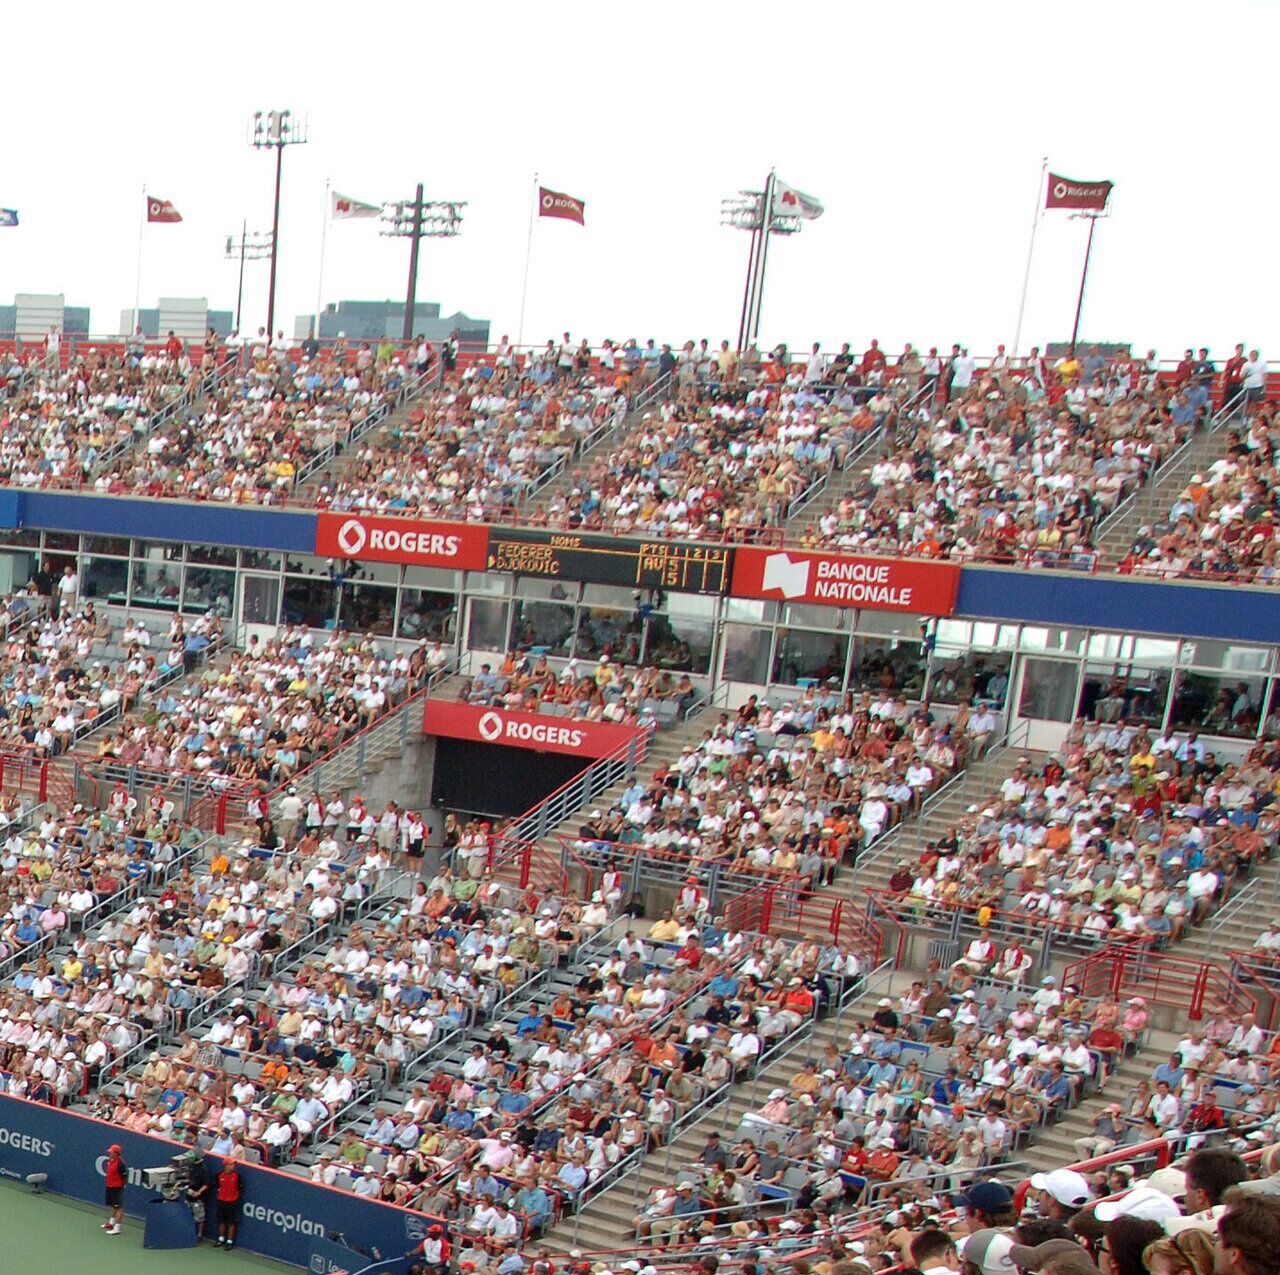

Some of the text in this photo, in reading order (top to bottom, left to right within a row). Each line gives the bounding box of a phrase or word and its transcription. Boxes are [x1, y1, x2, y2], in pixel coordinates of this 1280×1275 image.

[370, 530, 458, 556] ROGERS
[498, 545, 553, 566] FEDERER
[669, 559, 678, 572] 5
[496, 562, 678, 586] DJOKOVIC 5
[817, 560, 890, 584] BANQUE
[814, 581, 912, 606] NATIONALE
[506, 721, 582, 748] ROGERS
[243, 1201, 325, 1238] aeroplan
